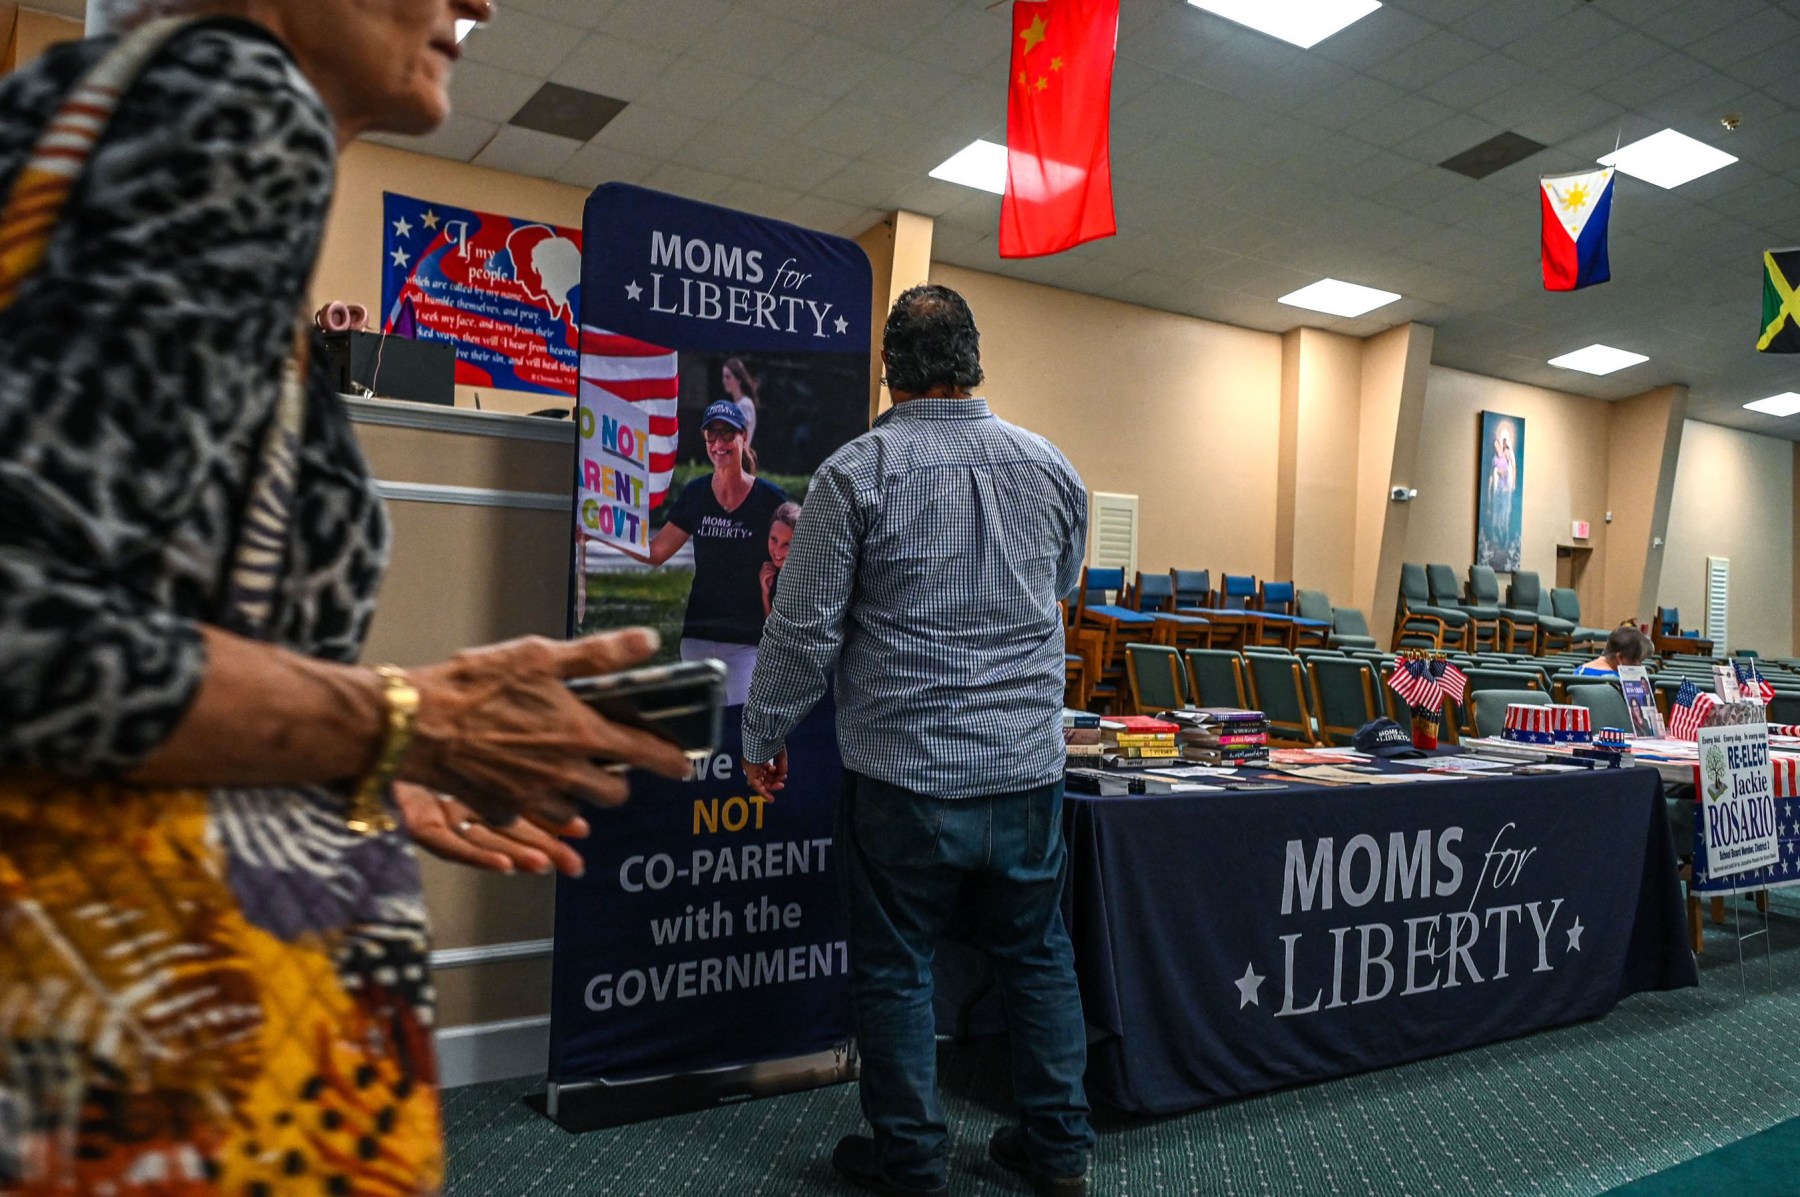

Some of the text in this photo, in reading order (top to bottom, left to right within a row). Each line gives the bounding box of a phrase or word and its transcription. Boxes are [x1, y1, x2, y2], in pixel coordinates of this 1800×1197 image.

[444, 220, 496, 268] If my
[405, 274, 430, 288] which
[432, 282, 448, 290] are
[450, 282, 473, 294] called
[474, 285, 484, 300] by
[486, 289, 500, 302] my
[650, 230, 812, 307] MOMS for
[421, 311, 439, 322] seek
[441, 315, 455, 329] my
[479, 319, 494, 330] and
[495, 322, 513, 332] turn
[514, 323, 534, 338] from
[535, 326, 555, 338] their
[425, 293, 455, 307] humble
[503, 306, 518, 317] and
[650, 273, 833, 338] LIBERTY
[416, 326, 434, 338] ked
[462, 331, 480, 344] then
[482, 335, 499, 346] will
[508, 338, 527, 350] hear
[528, 341, 548, 356] from
[470, 349, 490, 362] their
[508, 356, 524, 366] and
[525, 357, 541, 368] will
[541, 358, 559, 370] heal
[559, 361, 578, 373] their
[580, 406, 648, 461] O NOT
[579, 458, 644, 509] RENT
[581, 498, 648, 549] GOVT!
[700, 526, 748, 538] LIBERTY
[702, 515, 731, 528] MOMS
[1379, 729, 1398, 737] MOMS
[1727, 743, 1767, 770] RE-ELECT
[1732, 770, 1768, 800] Jackie
[693, 796, 769, 835] NOT
[1708, 795, 1774, 848] ROSARIO
[619, 838, 833, 893] CO-PARENT
[1281, 822, 1537, 935] MOMS for
[650, 896, 802, 946] with the
[583, 940, 848, 1011] GOVERNMENT
[1274, 898, 1565, 1017] LIBERTY
